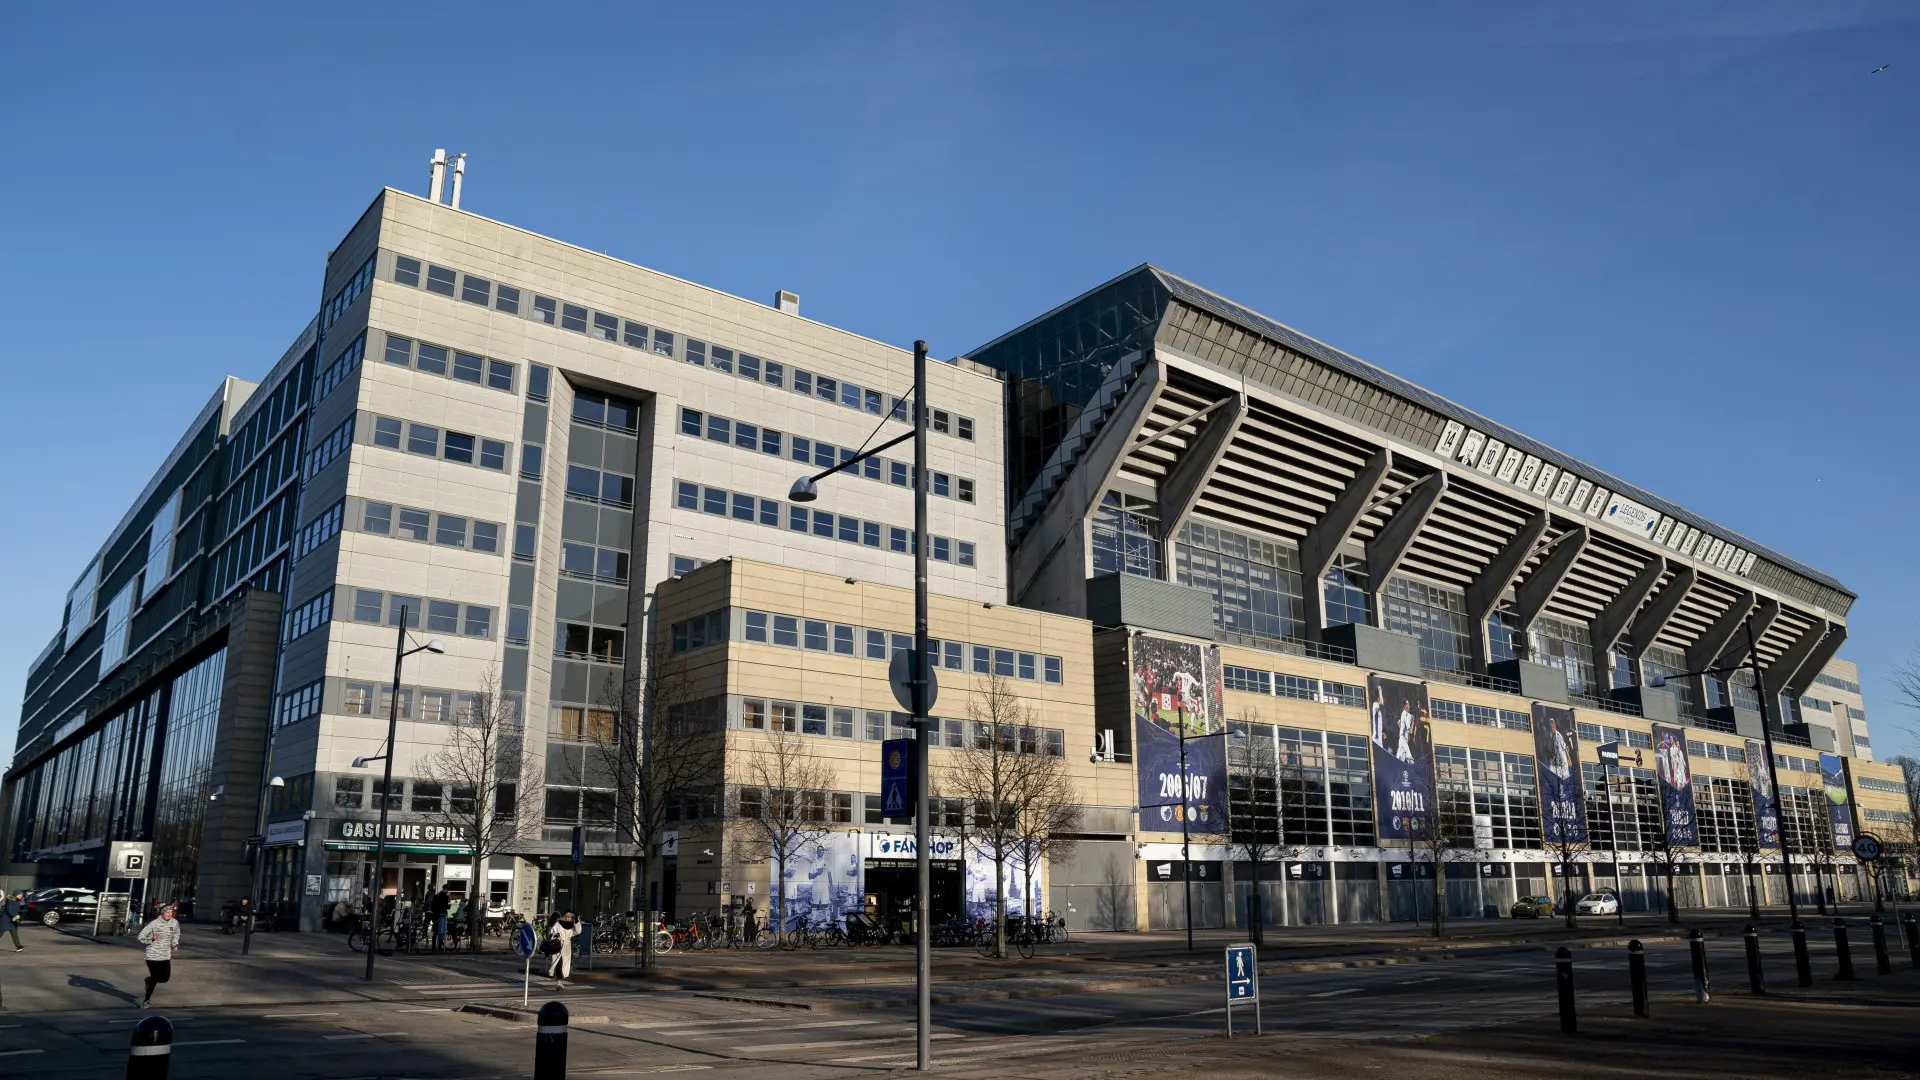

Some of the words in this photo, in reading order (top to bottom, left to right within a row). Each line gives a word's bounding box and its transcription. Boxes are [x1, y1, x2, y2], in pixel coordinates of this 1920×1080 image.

[1444, 430, 1456, 447] 14
[1485, 449, 1496, 465] 10
[1504, 457, 1516, 473] 17
[1523, 465, 1534, 481] 12
[1620, 504, 1647, 521] LEGENDS
[1391, 790, 1425, 813] 2010/11
[424, 826, 466, 841] GRILL
[893, 840, 954, 854] FANHOP
[1858, 843, 1877, 854] 40
[129, 857, 140, 868] P
